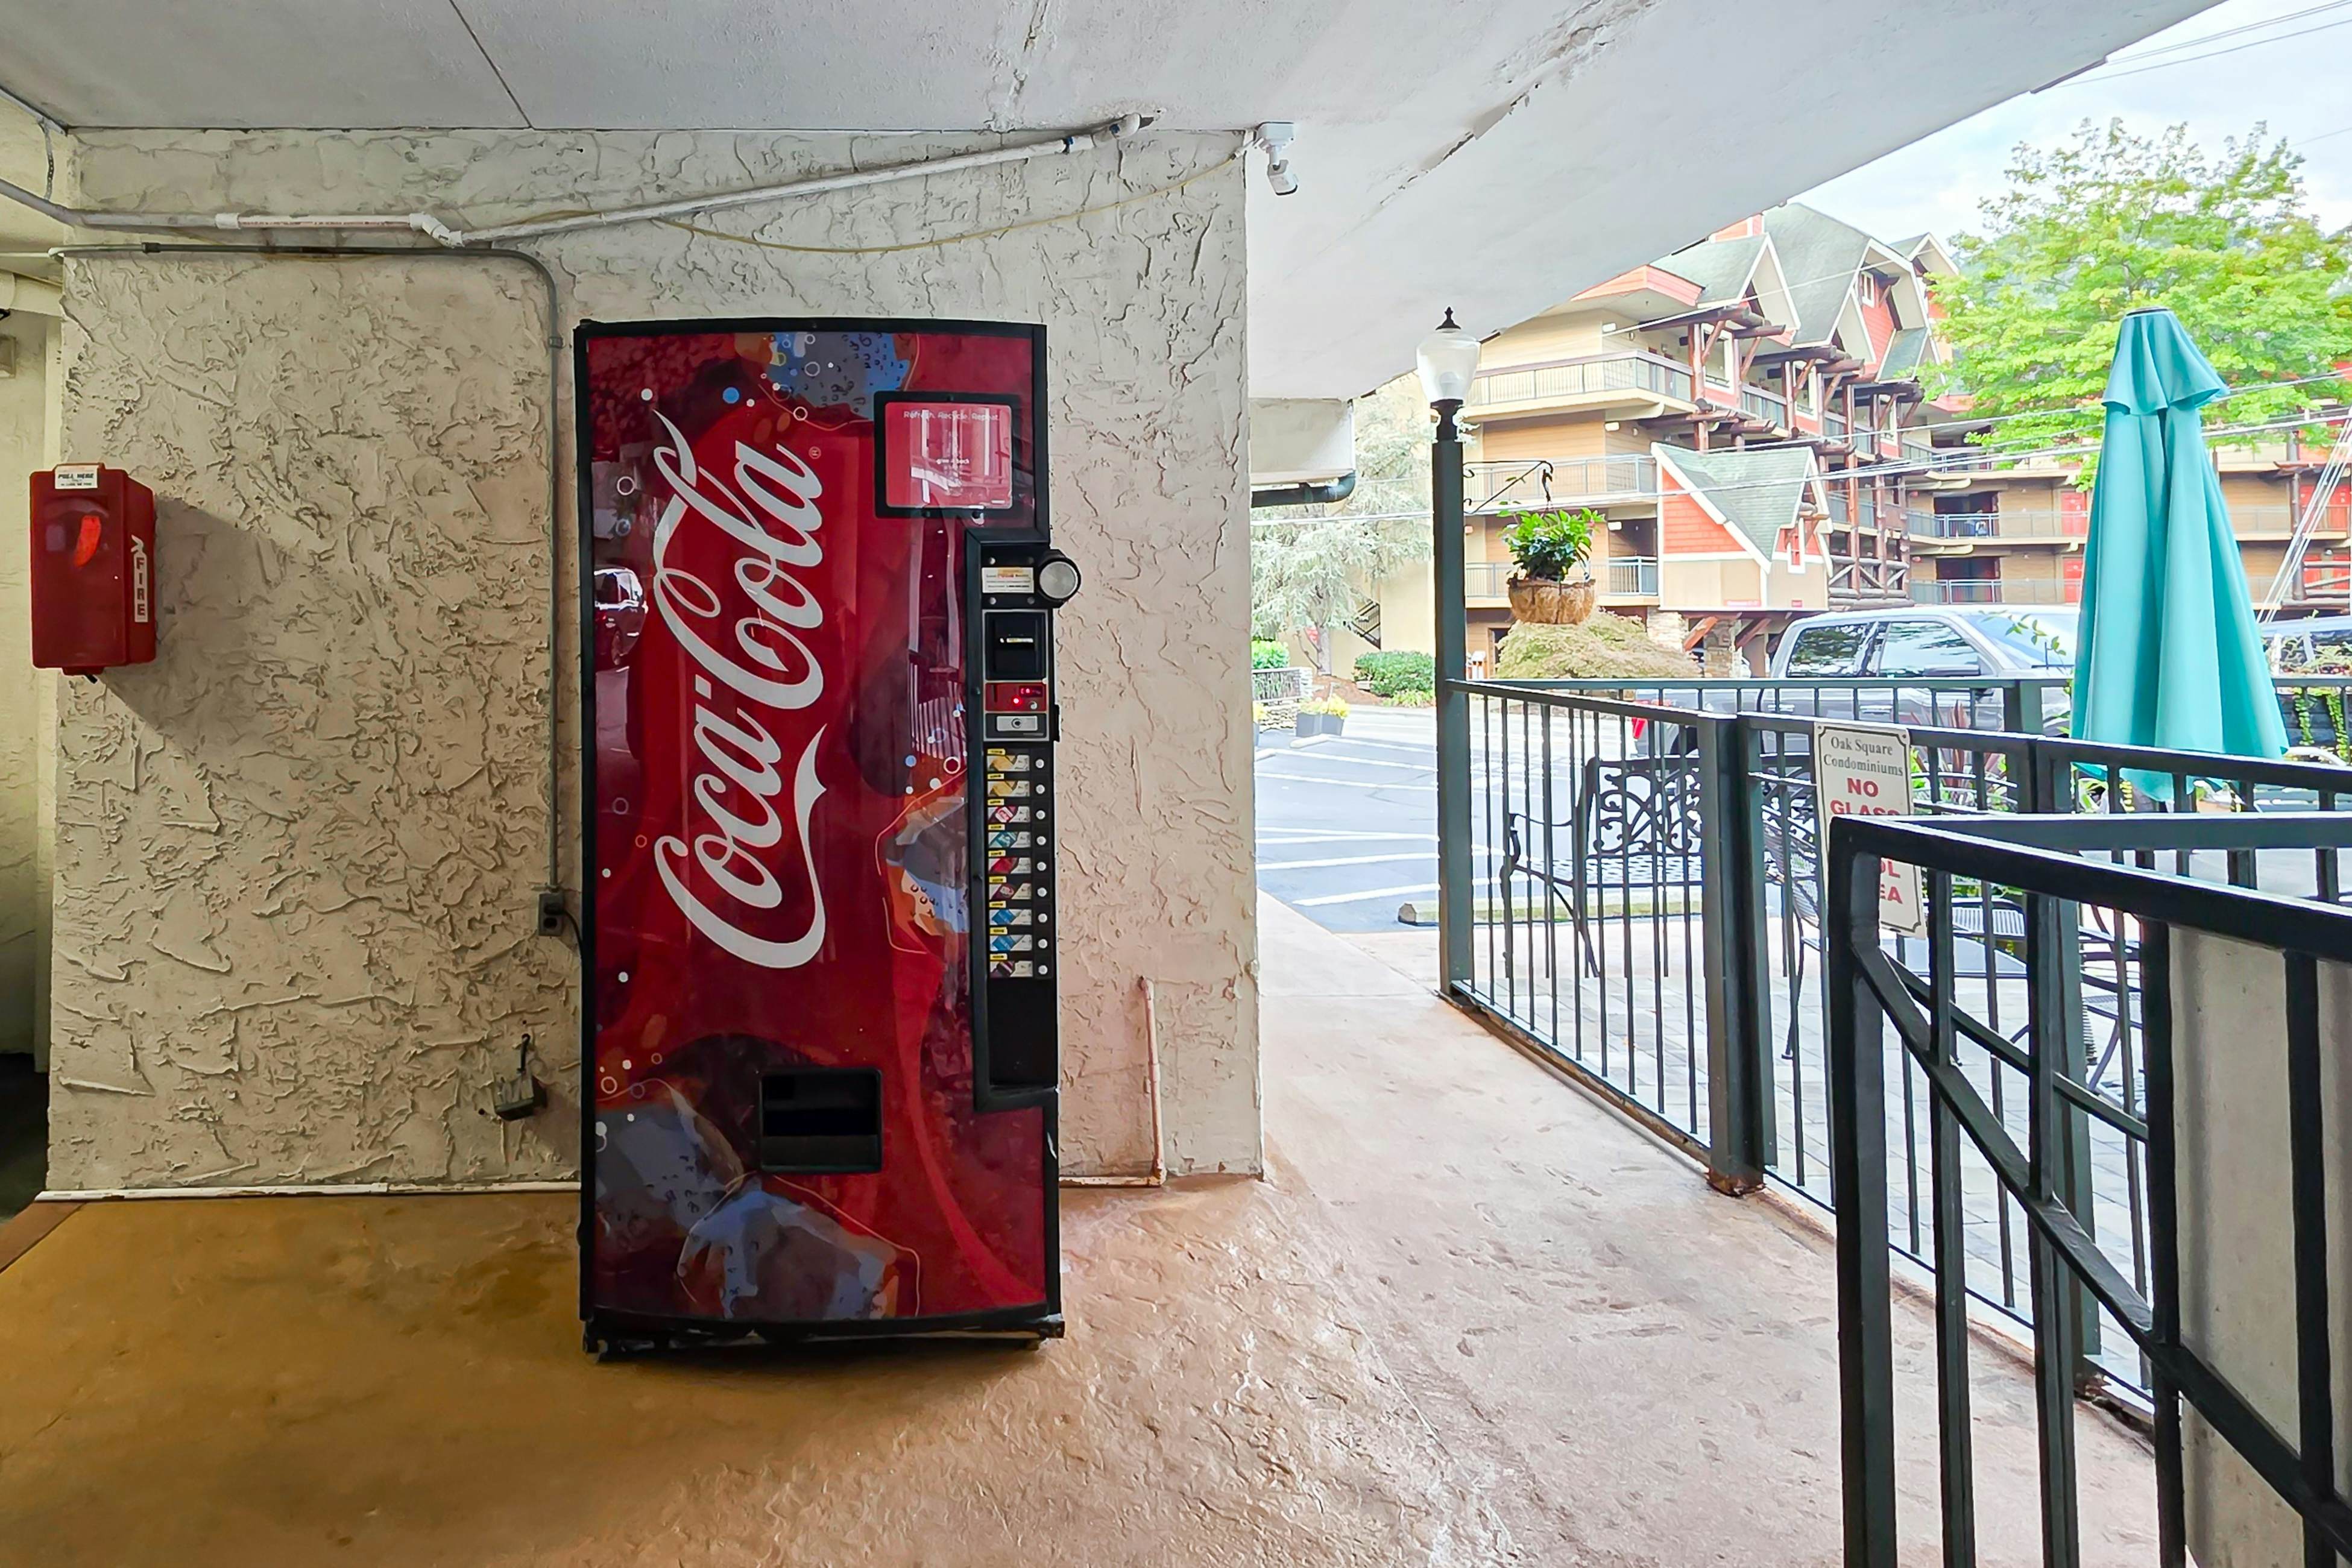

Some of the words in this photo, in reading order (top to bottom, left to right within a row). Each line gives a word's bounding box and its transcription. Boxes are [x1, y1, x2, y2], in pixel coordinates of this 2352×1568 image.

[904, 411, 935, 419] Refrh.
[971, 412, 999, 421] Repat.
[136, 556, 145, 616] FIRE
[653, 410, 826, 968] Coca-Cola
[1830, 736, 1852, 751] Oak
[1855, 738, 1893, 756] Square
[1823, 754, 1903, 776] Condominiums
[1847, 777, 1879, 797] NO
